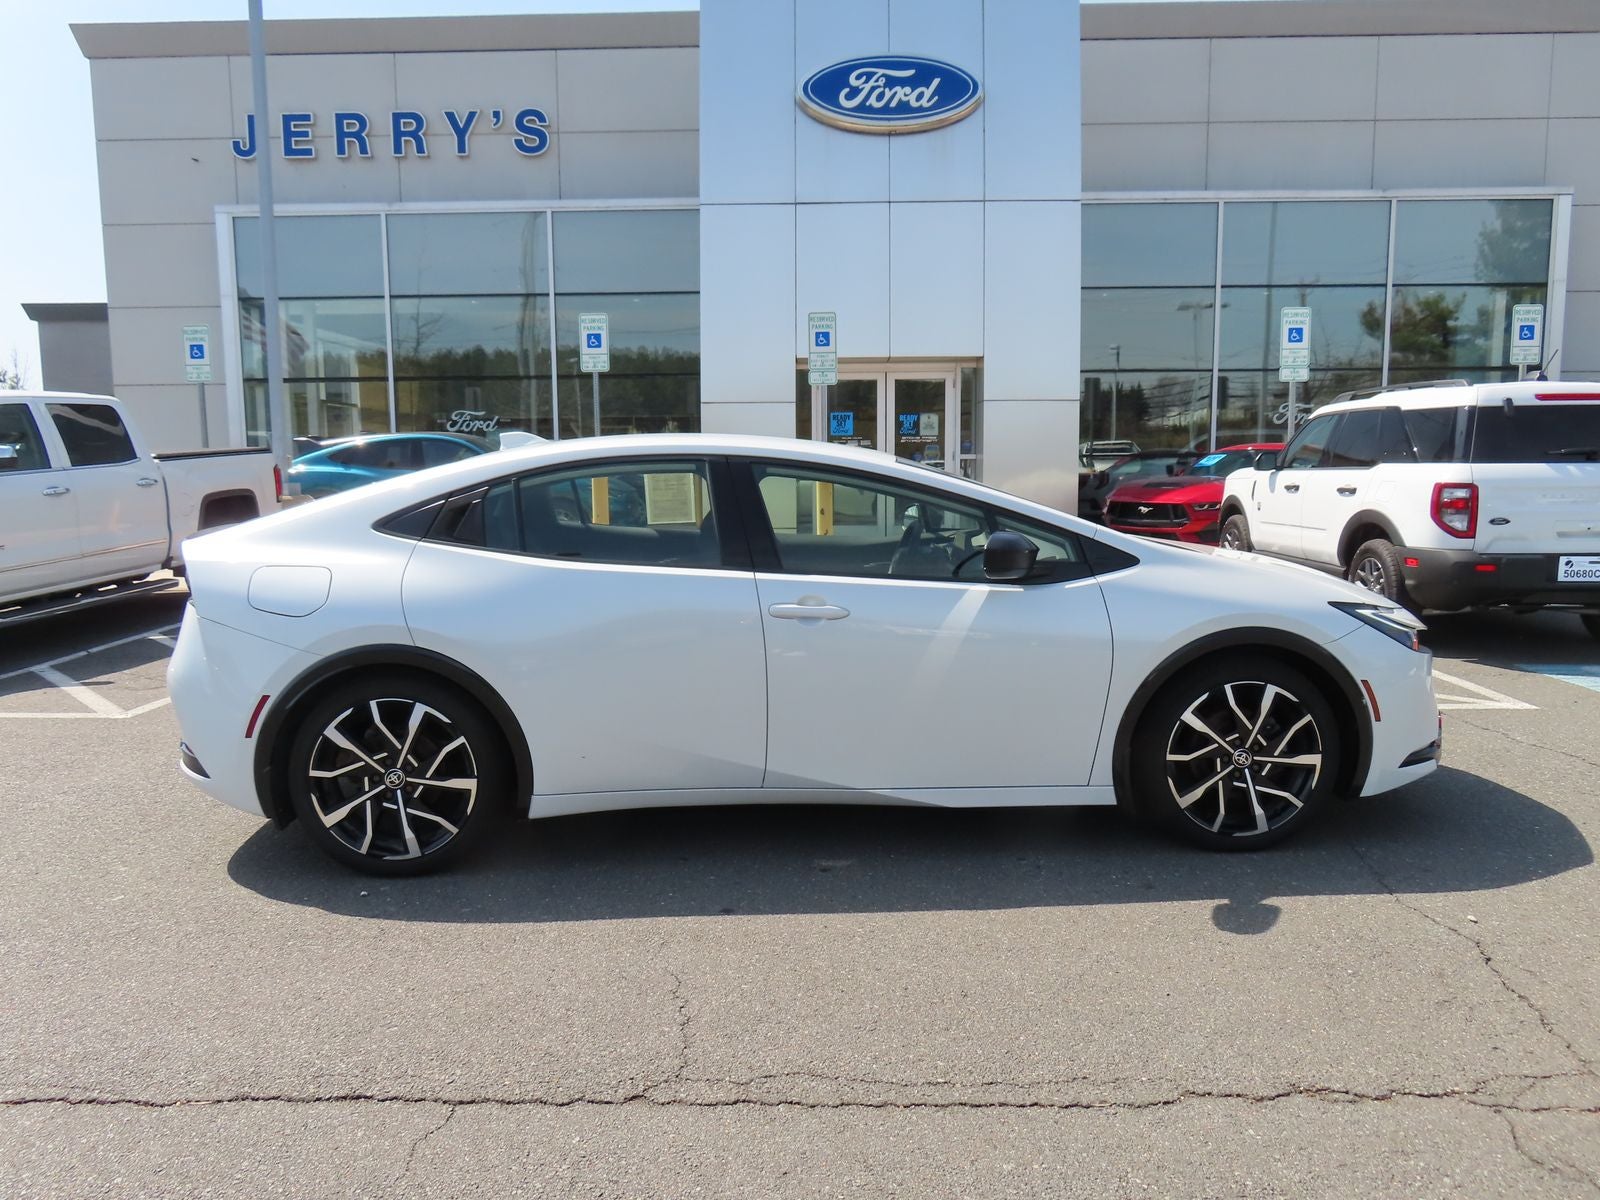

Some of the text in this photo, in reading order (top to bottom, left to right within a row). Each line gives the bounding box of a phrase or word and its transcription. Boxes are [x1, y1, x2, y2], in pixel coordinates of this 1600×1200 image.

[838, 67, 942, 109] Ford
[231, 108, 551, 159] JERRY'S
[446, 410, 499, 432] Ford
[899, 414, 918, 422] READY
